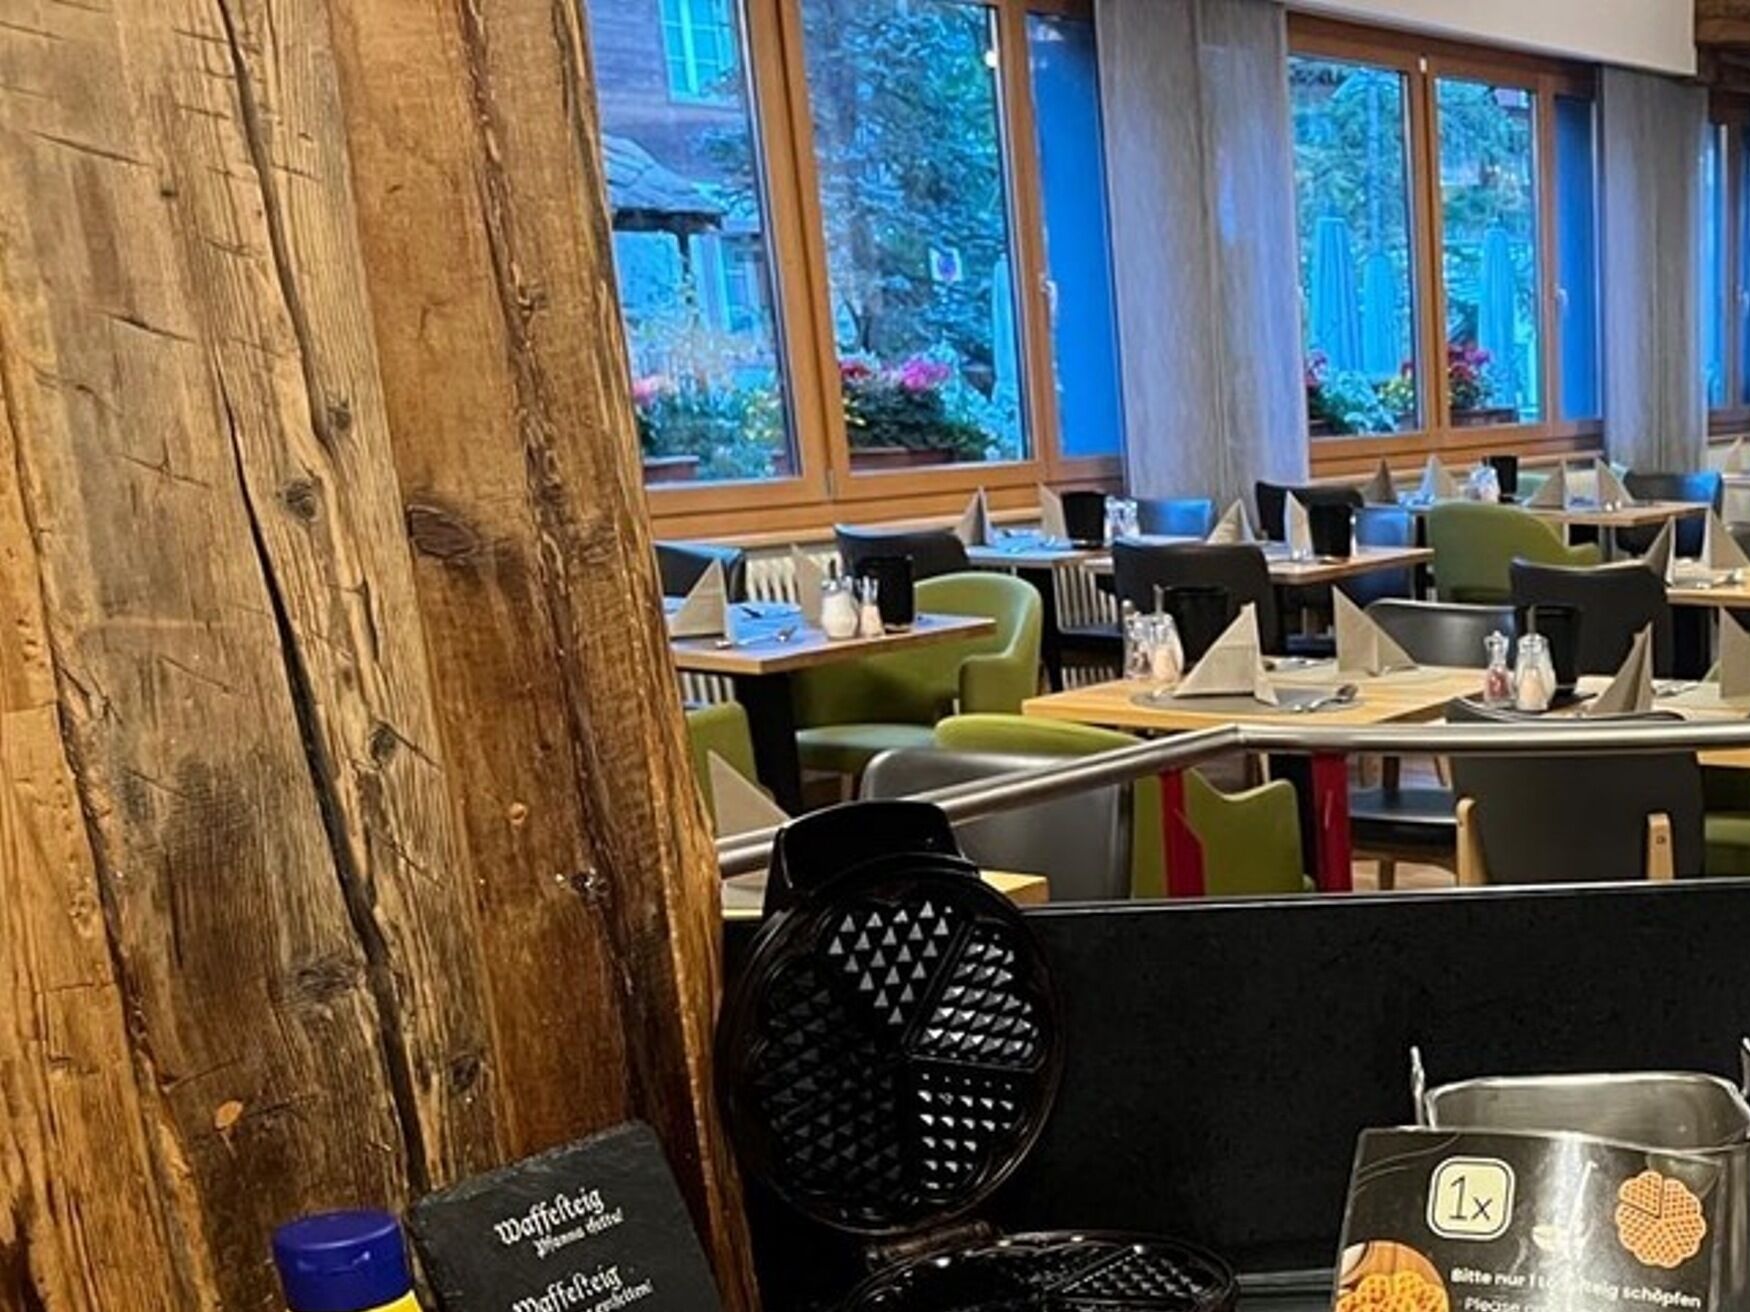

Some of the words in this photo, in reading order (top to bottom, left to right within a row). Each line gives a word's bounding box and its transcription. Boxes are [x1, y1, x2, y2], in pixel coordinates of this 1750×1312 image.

[1449, 1174, 1494, 1221] 1x
[1450, 1266, 1493, 1285] Bitte
[1494, 1273, 1526, 1287] nur
[1622, 1286, 1701, 1309] schöpfen
